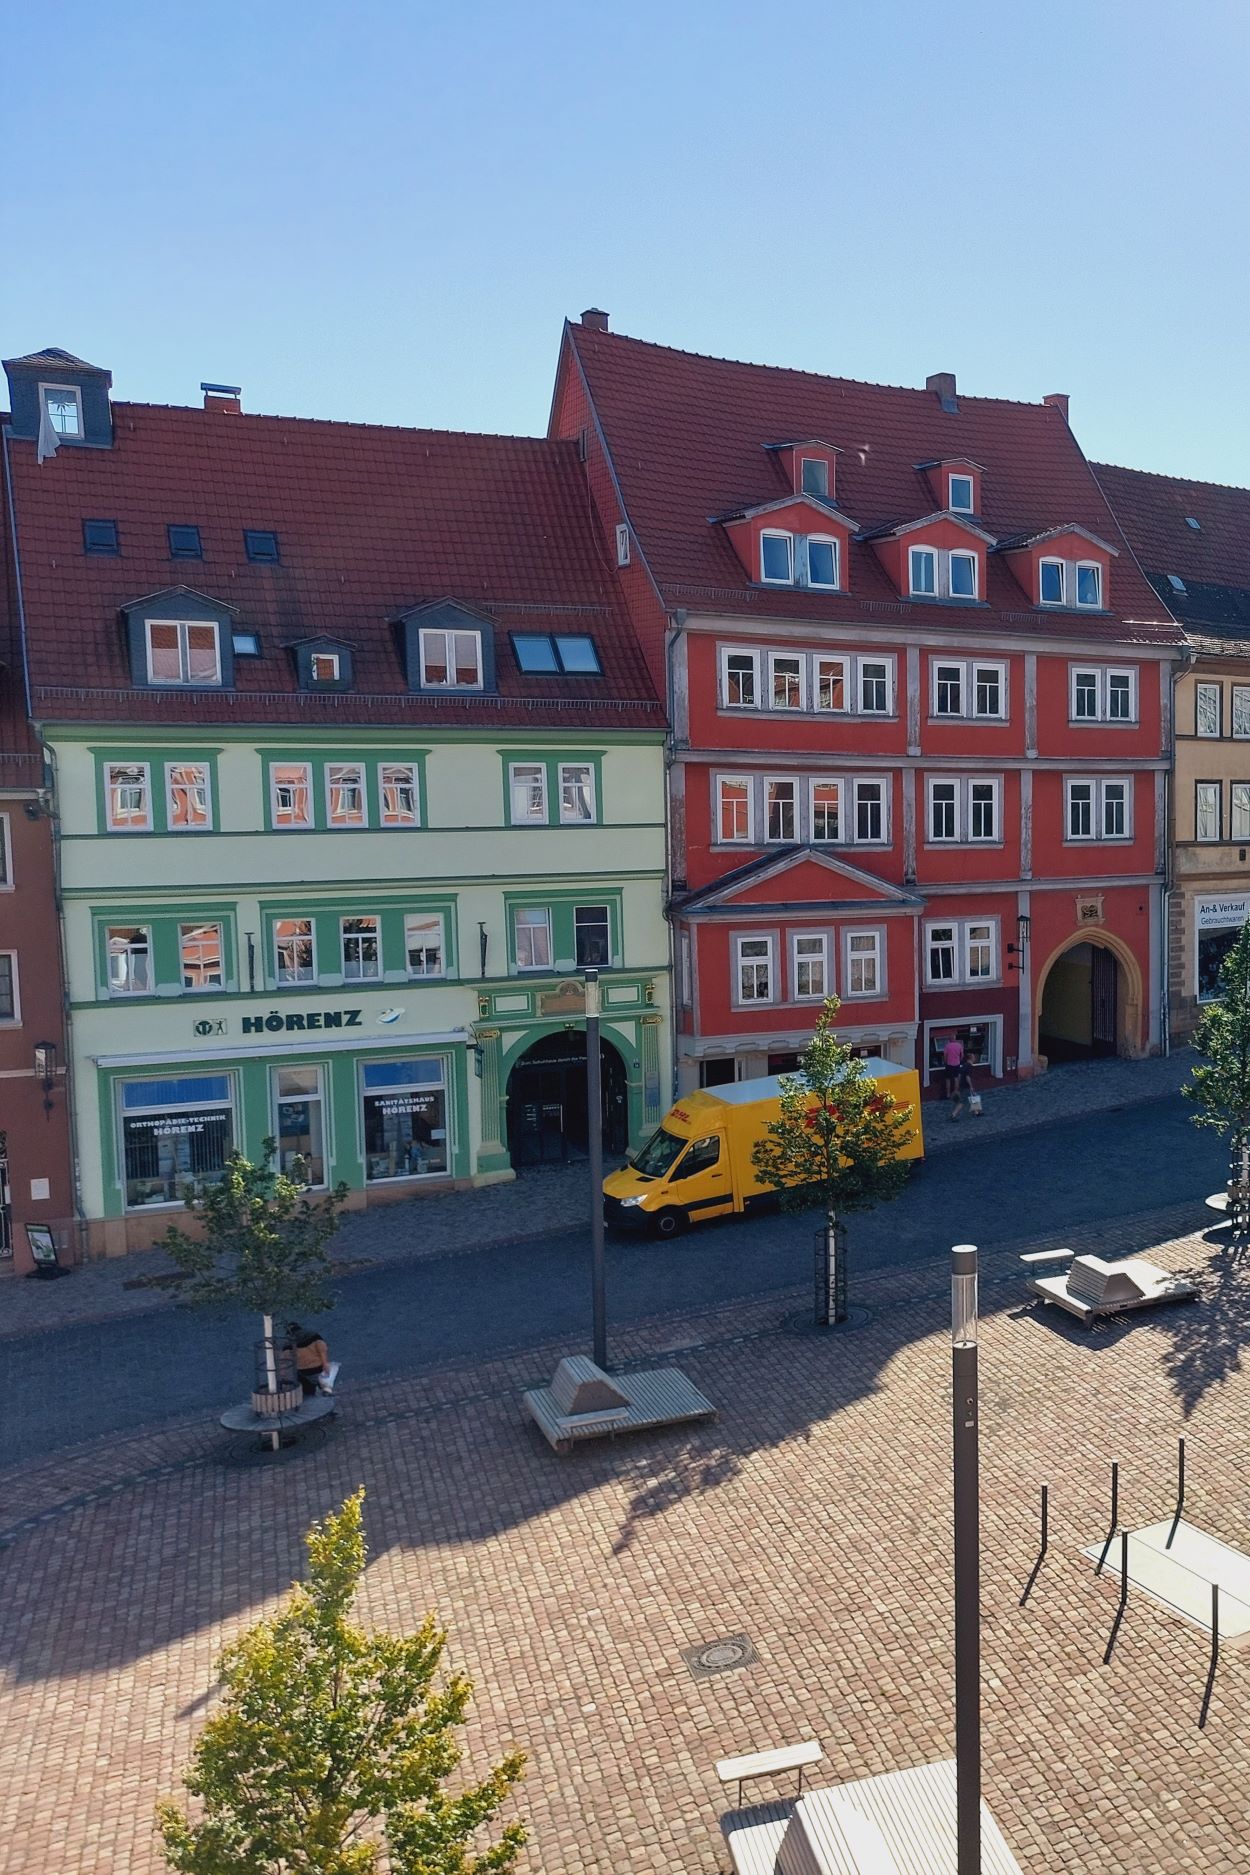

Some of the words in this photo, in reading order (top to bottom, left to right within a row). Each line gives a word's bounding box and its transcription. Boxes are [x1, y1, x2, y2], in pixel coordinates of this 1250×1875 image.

[1219, 902, 1245, 912] Verkauf
[242, 1010, 362, 1034] HÖRENZ
[374, 1096, 435, 1107] SANITÄTSHAUS
[382, 1104, 428, 1115] HÖRENZ
[153, 1124, 205, 1136] HÖRENZ
